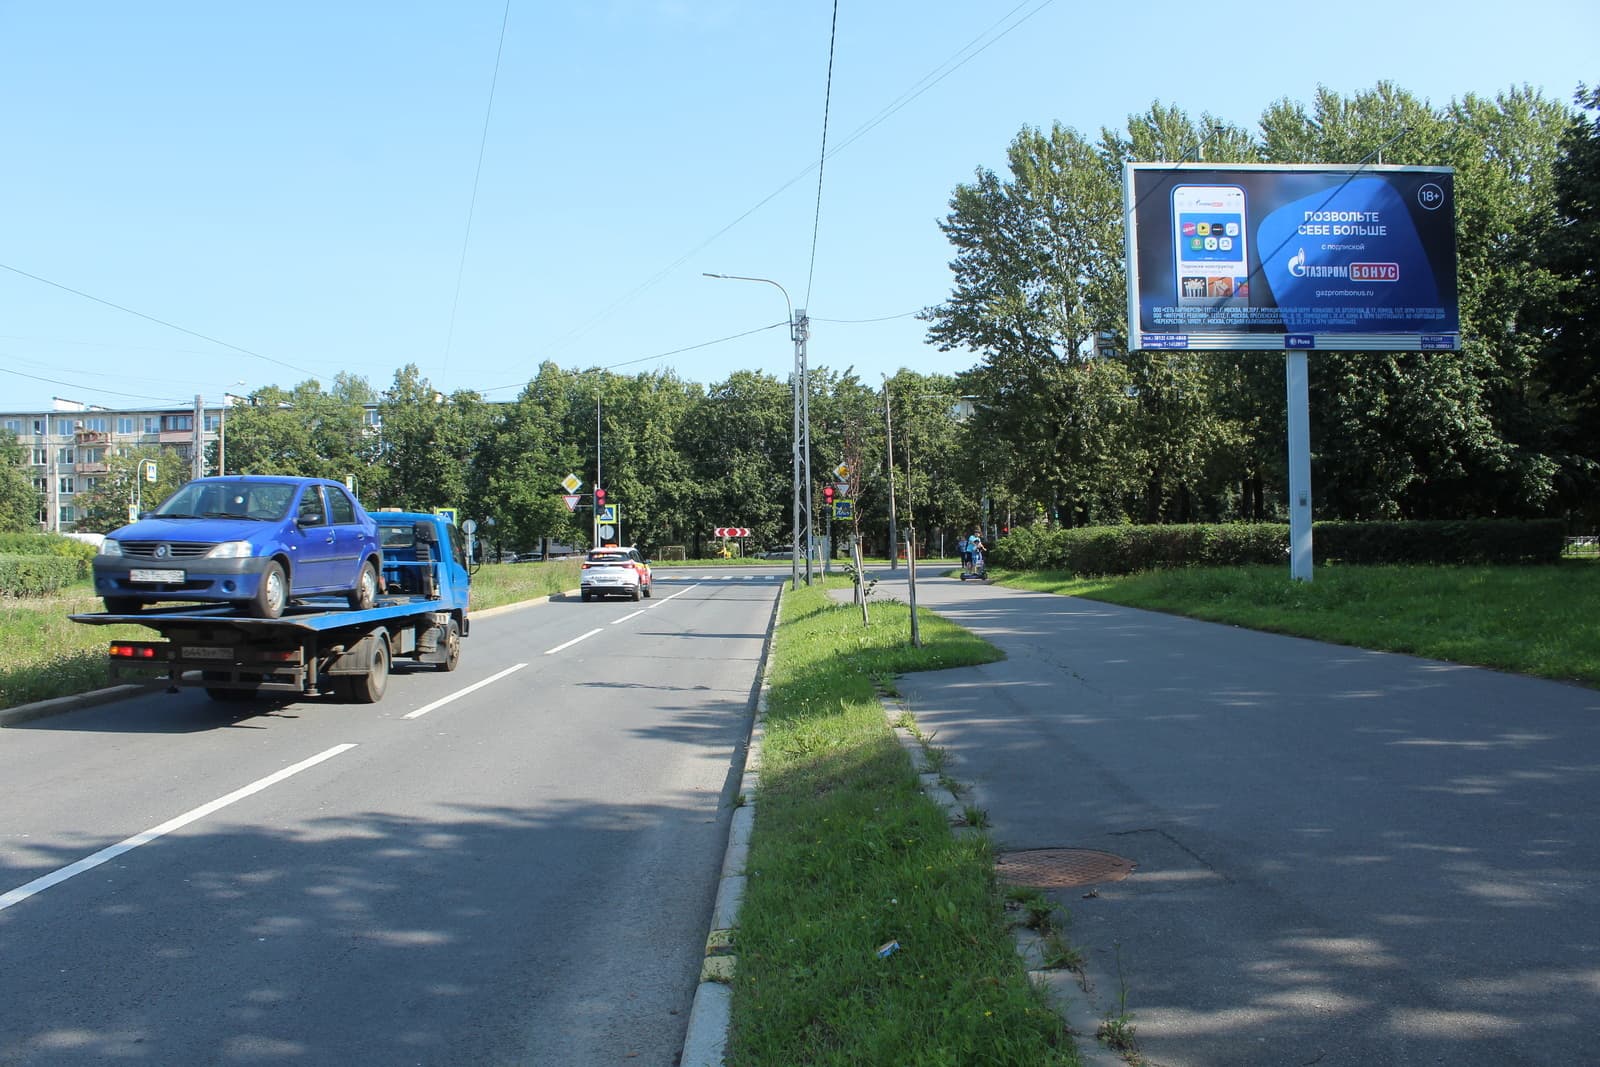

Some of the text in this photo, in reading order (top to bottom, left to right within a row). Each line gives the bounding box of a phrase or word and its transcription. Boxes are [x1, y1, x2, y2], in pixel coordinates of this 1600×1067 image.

[1422, 191, 1440, 202] 18+
[1304, 211, 1380, 223] ПОЗВОЛЬТЕ
[1297, 225, 1387, 236] СЕБЕ БОЛЬШЕ
[1327, 243, 1365, 251] подпиской
[1306, 265, 1396, 278] ГАЗПРОМ БОНУС
[1315, 289, 1375, 298] gazprombonus.ru
